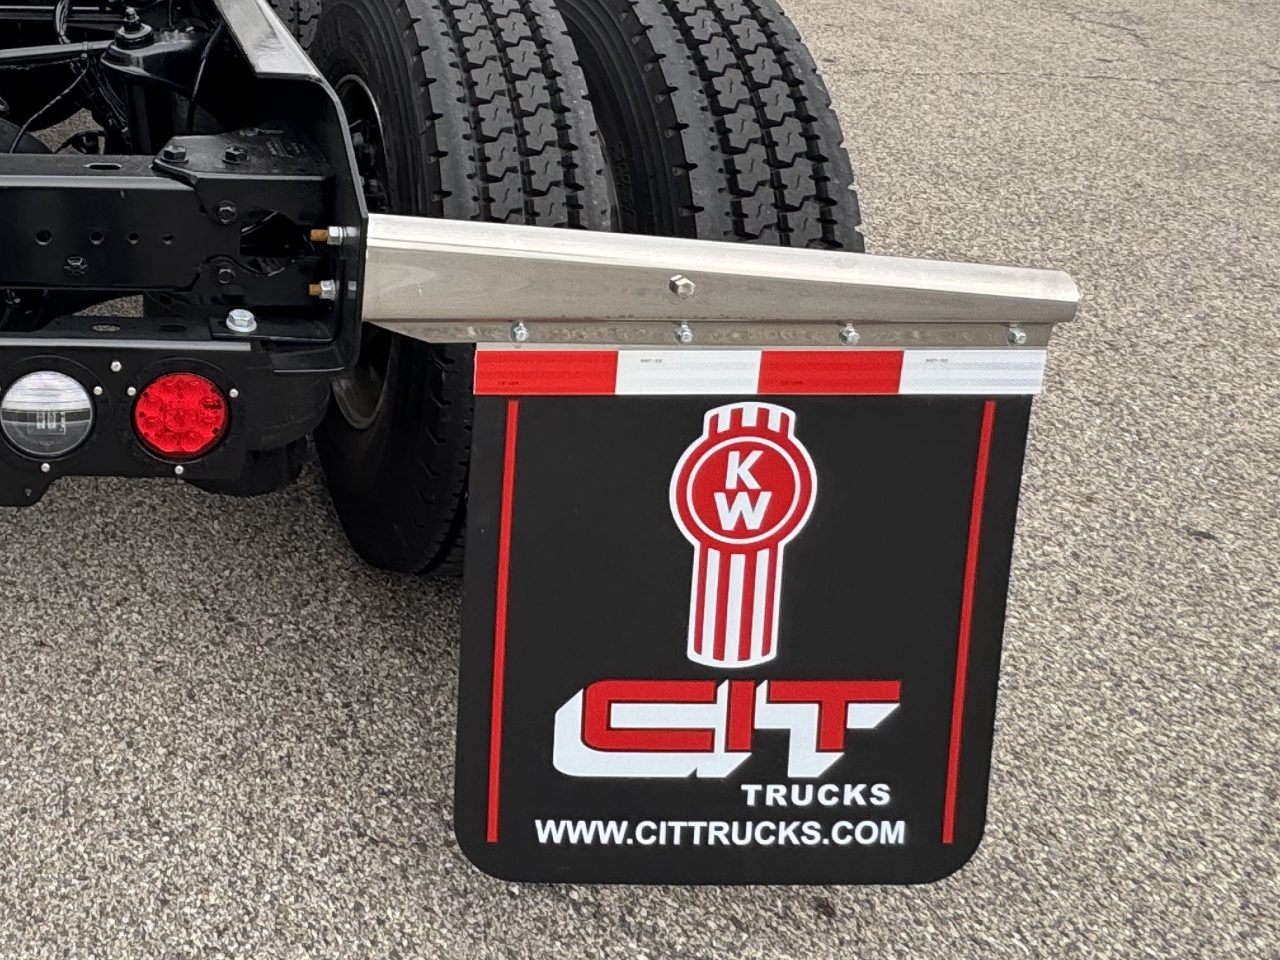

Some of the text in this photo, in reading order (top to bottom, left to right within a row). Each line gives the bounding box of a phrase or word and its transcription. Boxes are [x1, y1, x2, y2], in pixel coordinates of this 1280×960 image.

[553, 679, 901, 778] CIT
[740, 783, 891, 806] TRUCKS
[534, 819, 906, 846] WWW.CITTRUCKS.COM
